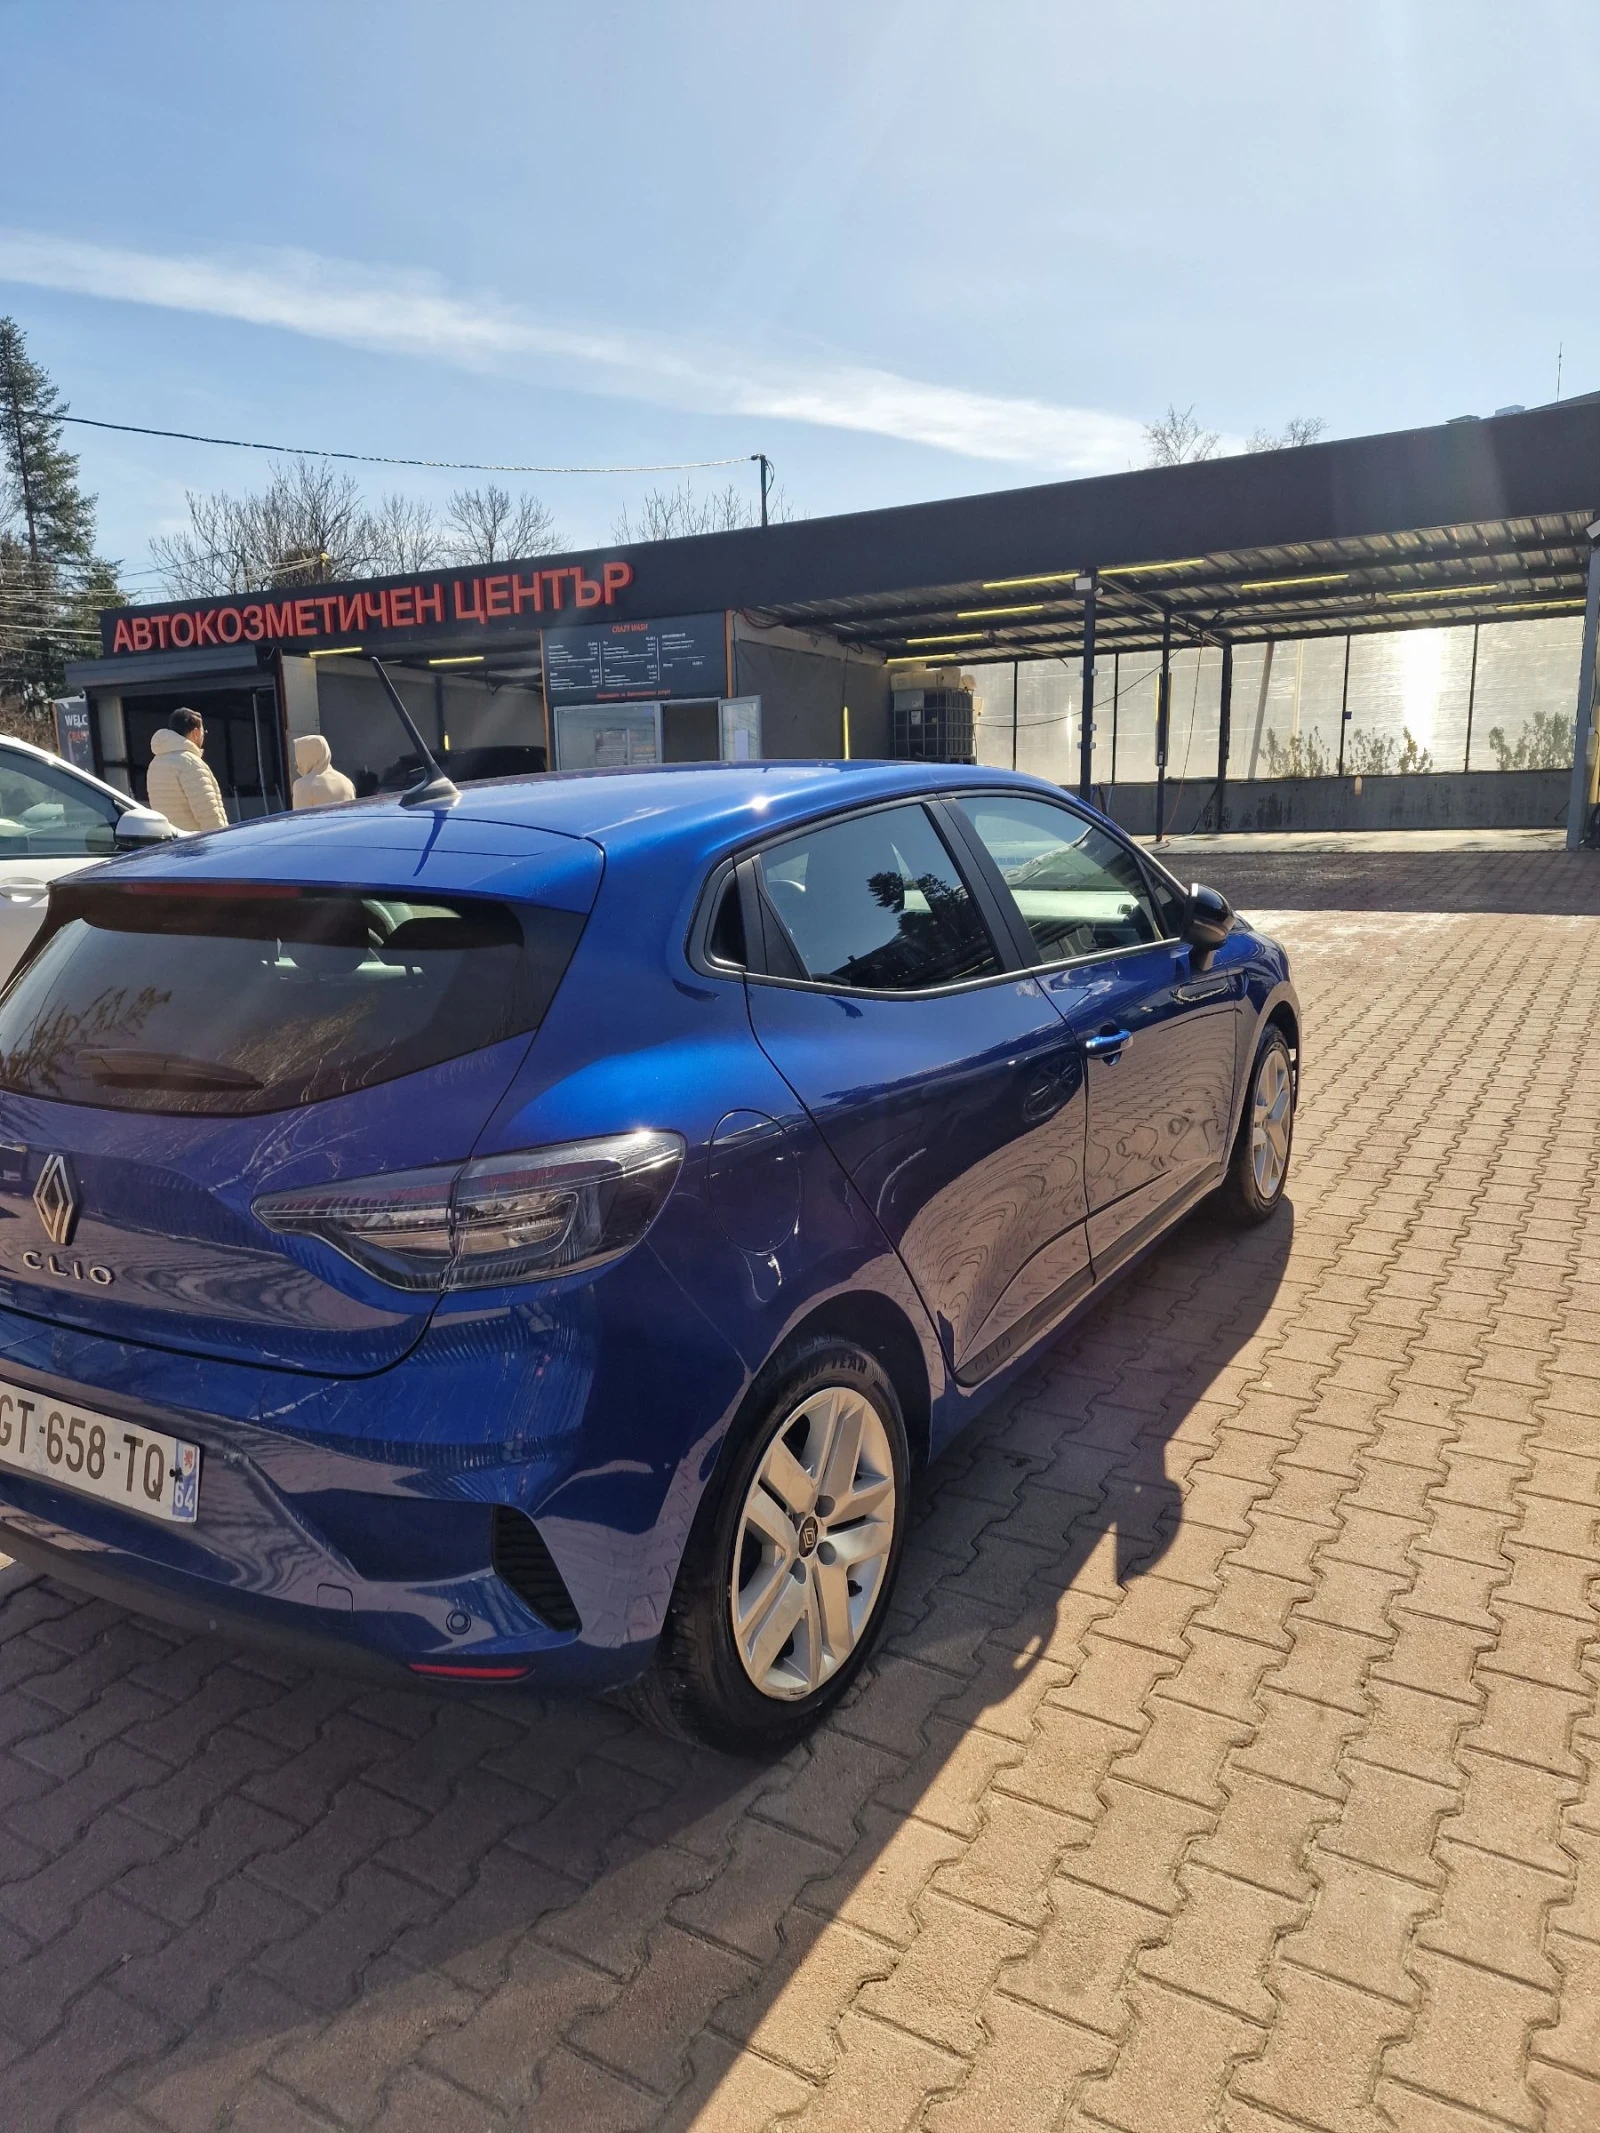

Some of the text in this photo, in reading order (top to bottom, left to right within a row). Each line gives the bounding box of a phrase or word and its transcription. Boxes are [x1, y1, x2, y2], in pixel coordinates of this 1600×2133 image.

[113, 561, 634, 654] АВТОКОЗМЕТИЧЕН ЦЕНТЪР
[23, 1250, 114, 1285] CLIO
[174, 1481, 194, 1512] 64
